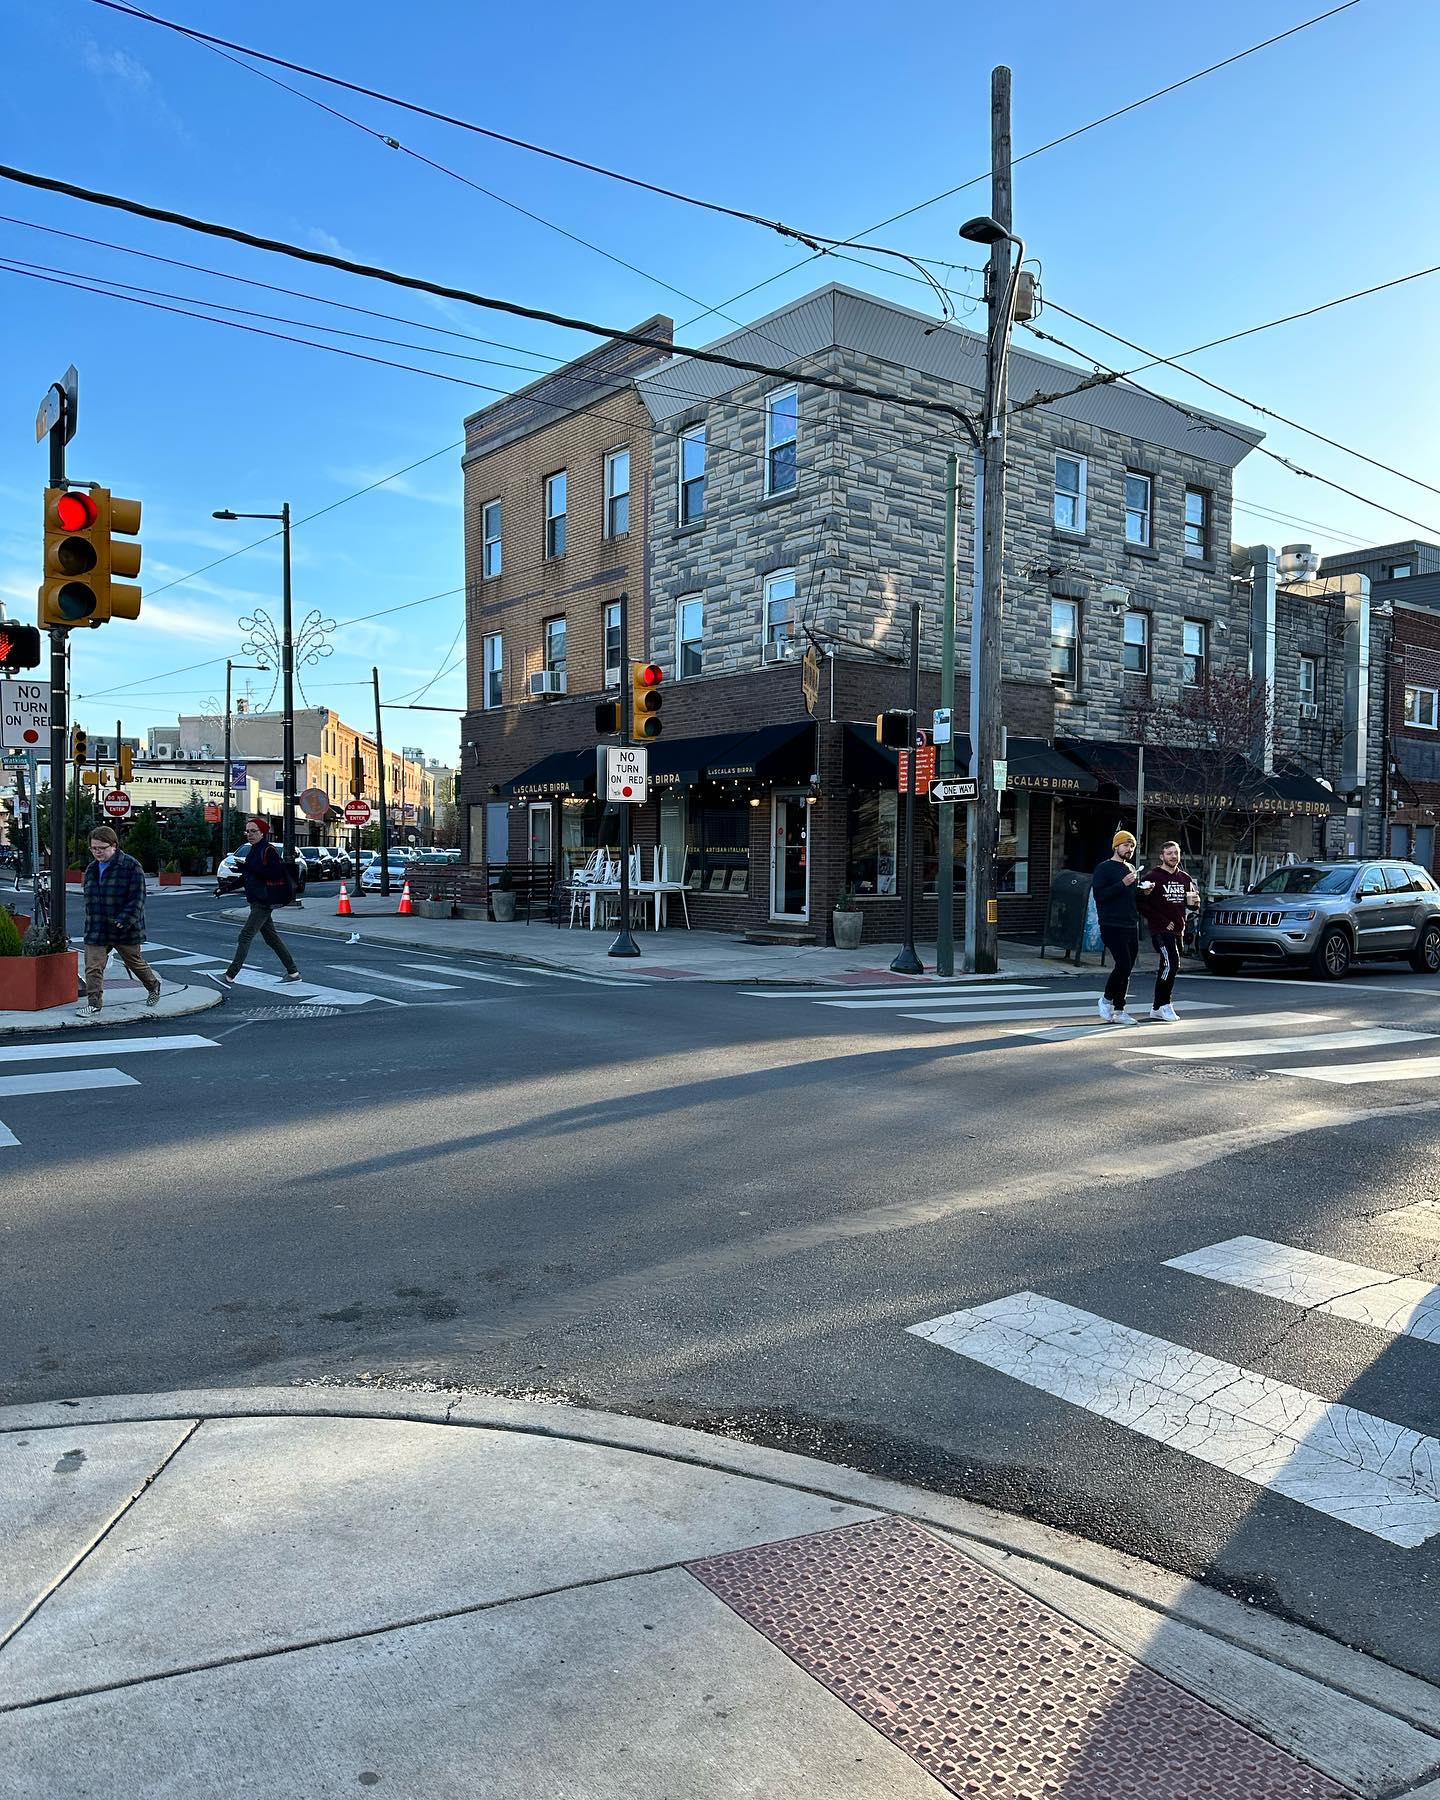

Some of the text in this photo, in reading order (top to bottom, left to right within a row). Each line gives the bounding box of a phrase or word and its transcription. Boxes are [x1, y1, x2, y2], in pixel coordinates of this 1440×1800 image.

[19, 685, 40, 698] NO
[13, 702, 48, 713] TURN
[6, 715, 21, 726] ON
[620, 752, 635, 762] NO
[617, 764, 639, 773] TURN
[147, 777, 187, 785] ANYTHING
[190, 778, 212, 786] EXCEPT
[611, 775, 622, 784] ON
[628, 776, 644, 784] RED
[655, 774, 680, 784] BIRRA
[1007, 775, 1080, 789] SCALA'S BIRRA
[549, 782, 570, 792] BIRRA
[944, 783, 974, 795] ONE WAY
[1305, 802, 1331, 813] BIRRA
[1162, 884, 1185, 894] VANS
